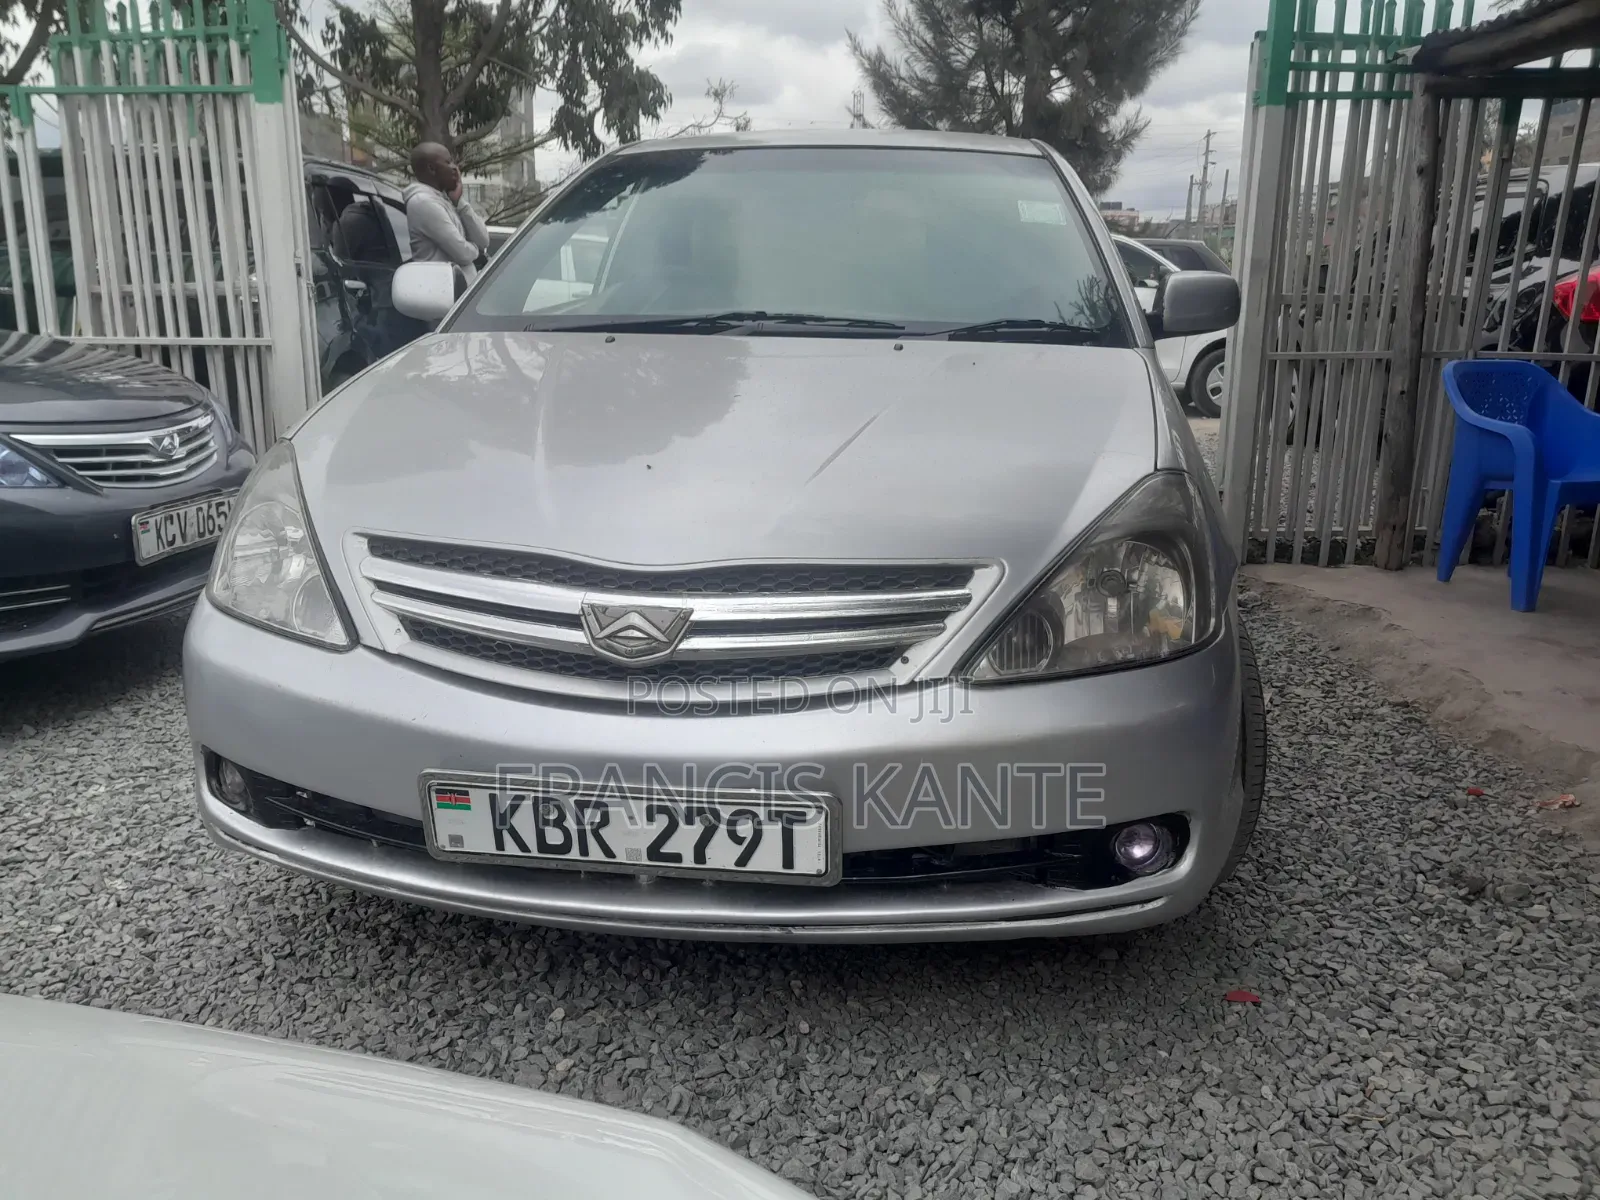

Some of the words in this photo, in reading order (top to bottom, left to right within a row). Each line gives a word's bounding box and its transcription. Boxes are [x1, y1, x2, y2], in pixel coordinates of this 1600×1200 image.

[155, 510, 188, 551] KCV
[489, 792, 617, 859] KBR
[646, 803, 808, 870] 279T
